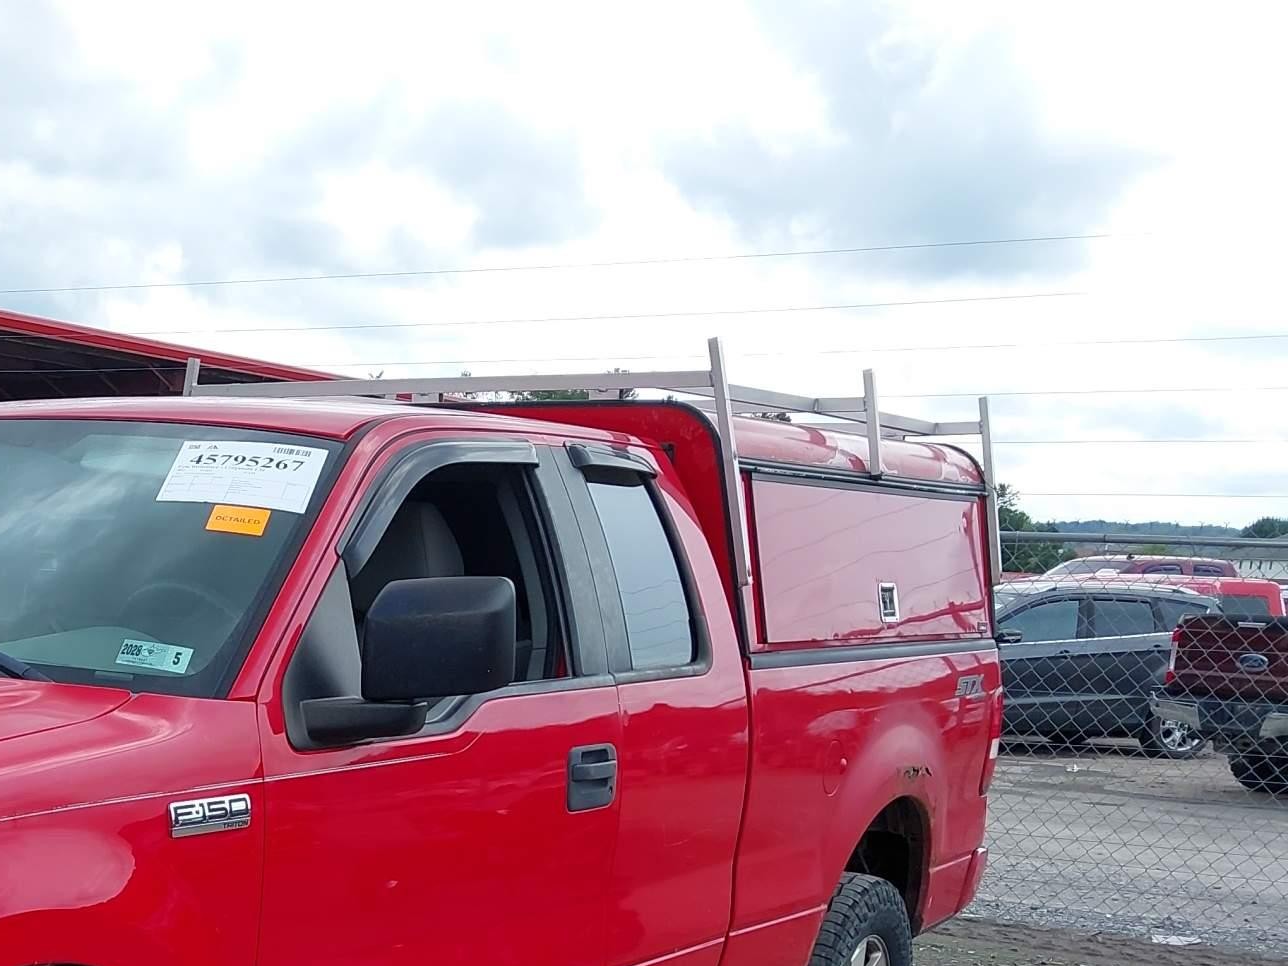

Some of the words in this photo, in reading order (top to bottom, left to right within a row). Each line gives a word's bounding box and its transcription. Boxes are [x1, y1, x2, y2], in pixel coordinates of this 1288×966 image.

[189, 453, 306, 472] 45795267
[172, 652, 183, 666] 5
[954, 674, 986, 698] STX
